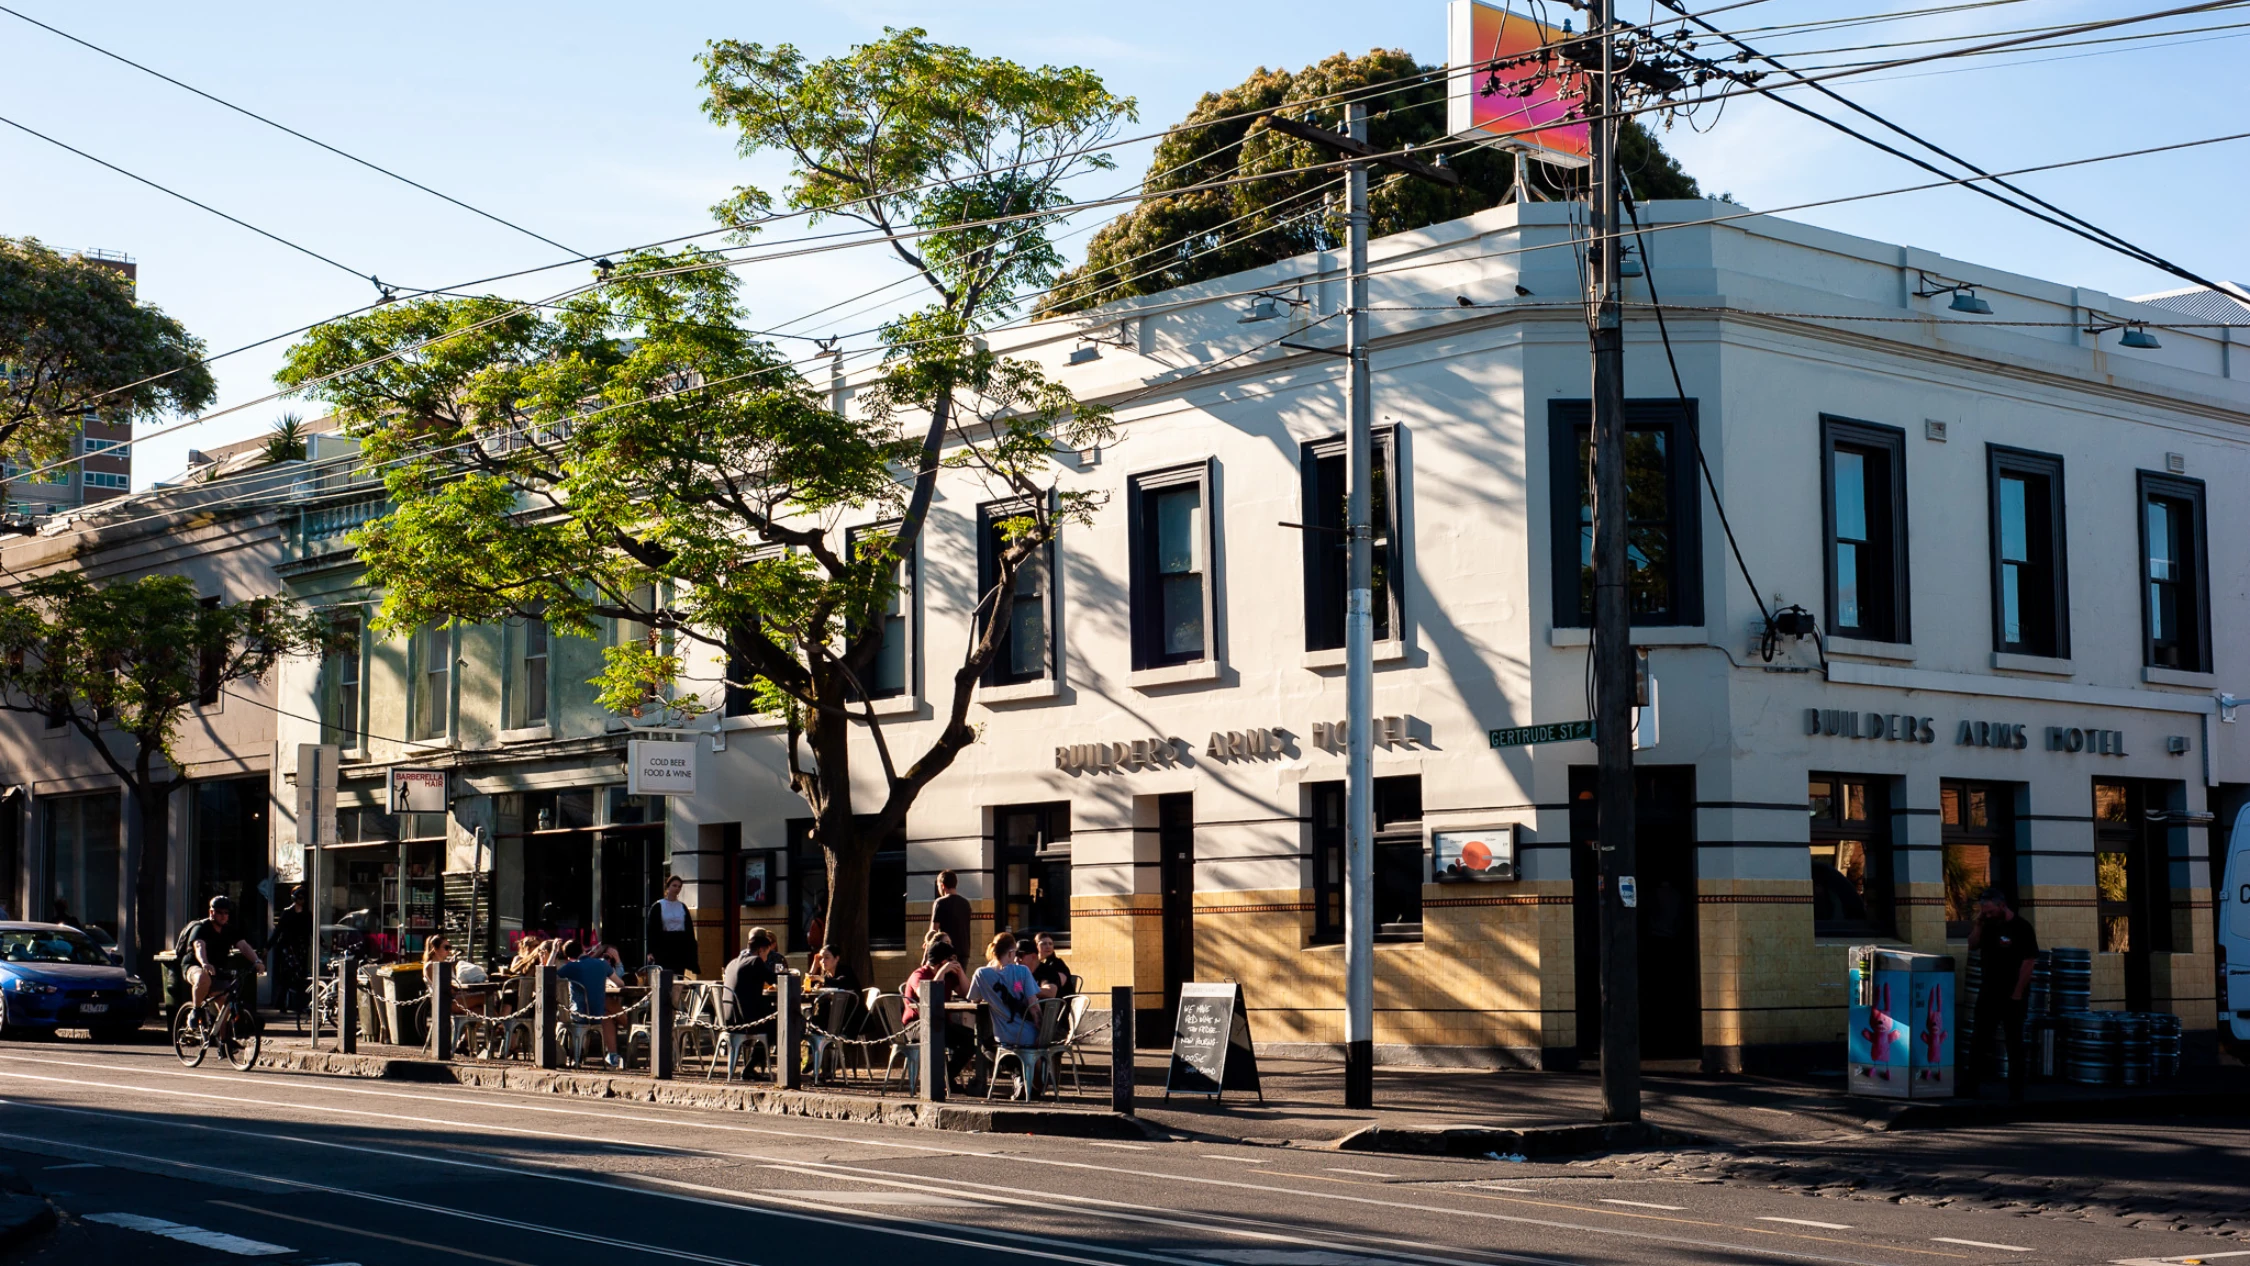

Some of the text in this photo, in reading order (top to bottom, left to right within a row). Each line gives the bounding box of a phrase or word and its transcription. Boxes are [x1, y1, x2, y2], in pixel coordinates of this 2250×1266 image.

[1491, 723, 1575, 747] GERTRUDE ST
[1804, 708, 2130, 757] BUILDERS ARMS HOTEL
[1055, 713, 1421, 770] BUILDERS ARMS HOEL
[650, 757, 686, 767] COLD BEER
[395, 772, 444, 781] BARBERELLA
[644, 768, 692, 778] FOOD & WINE
[425, 780, 444, 788] HAIR
